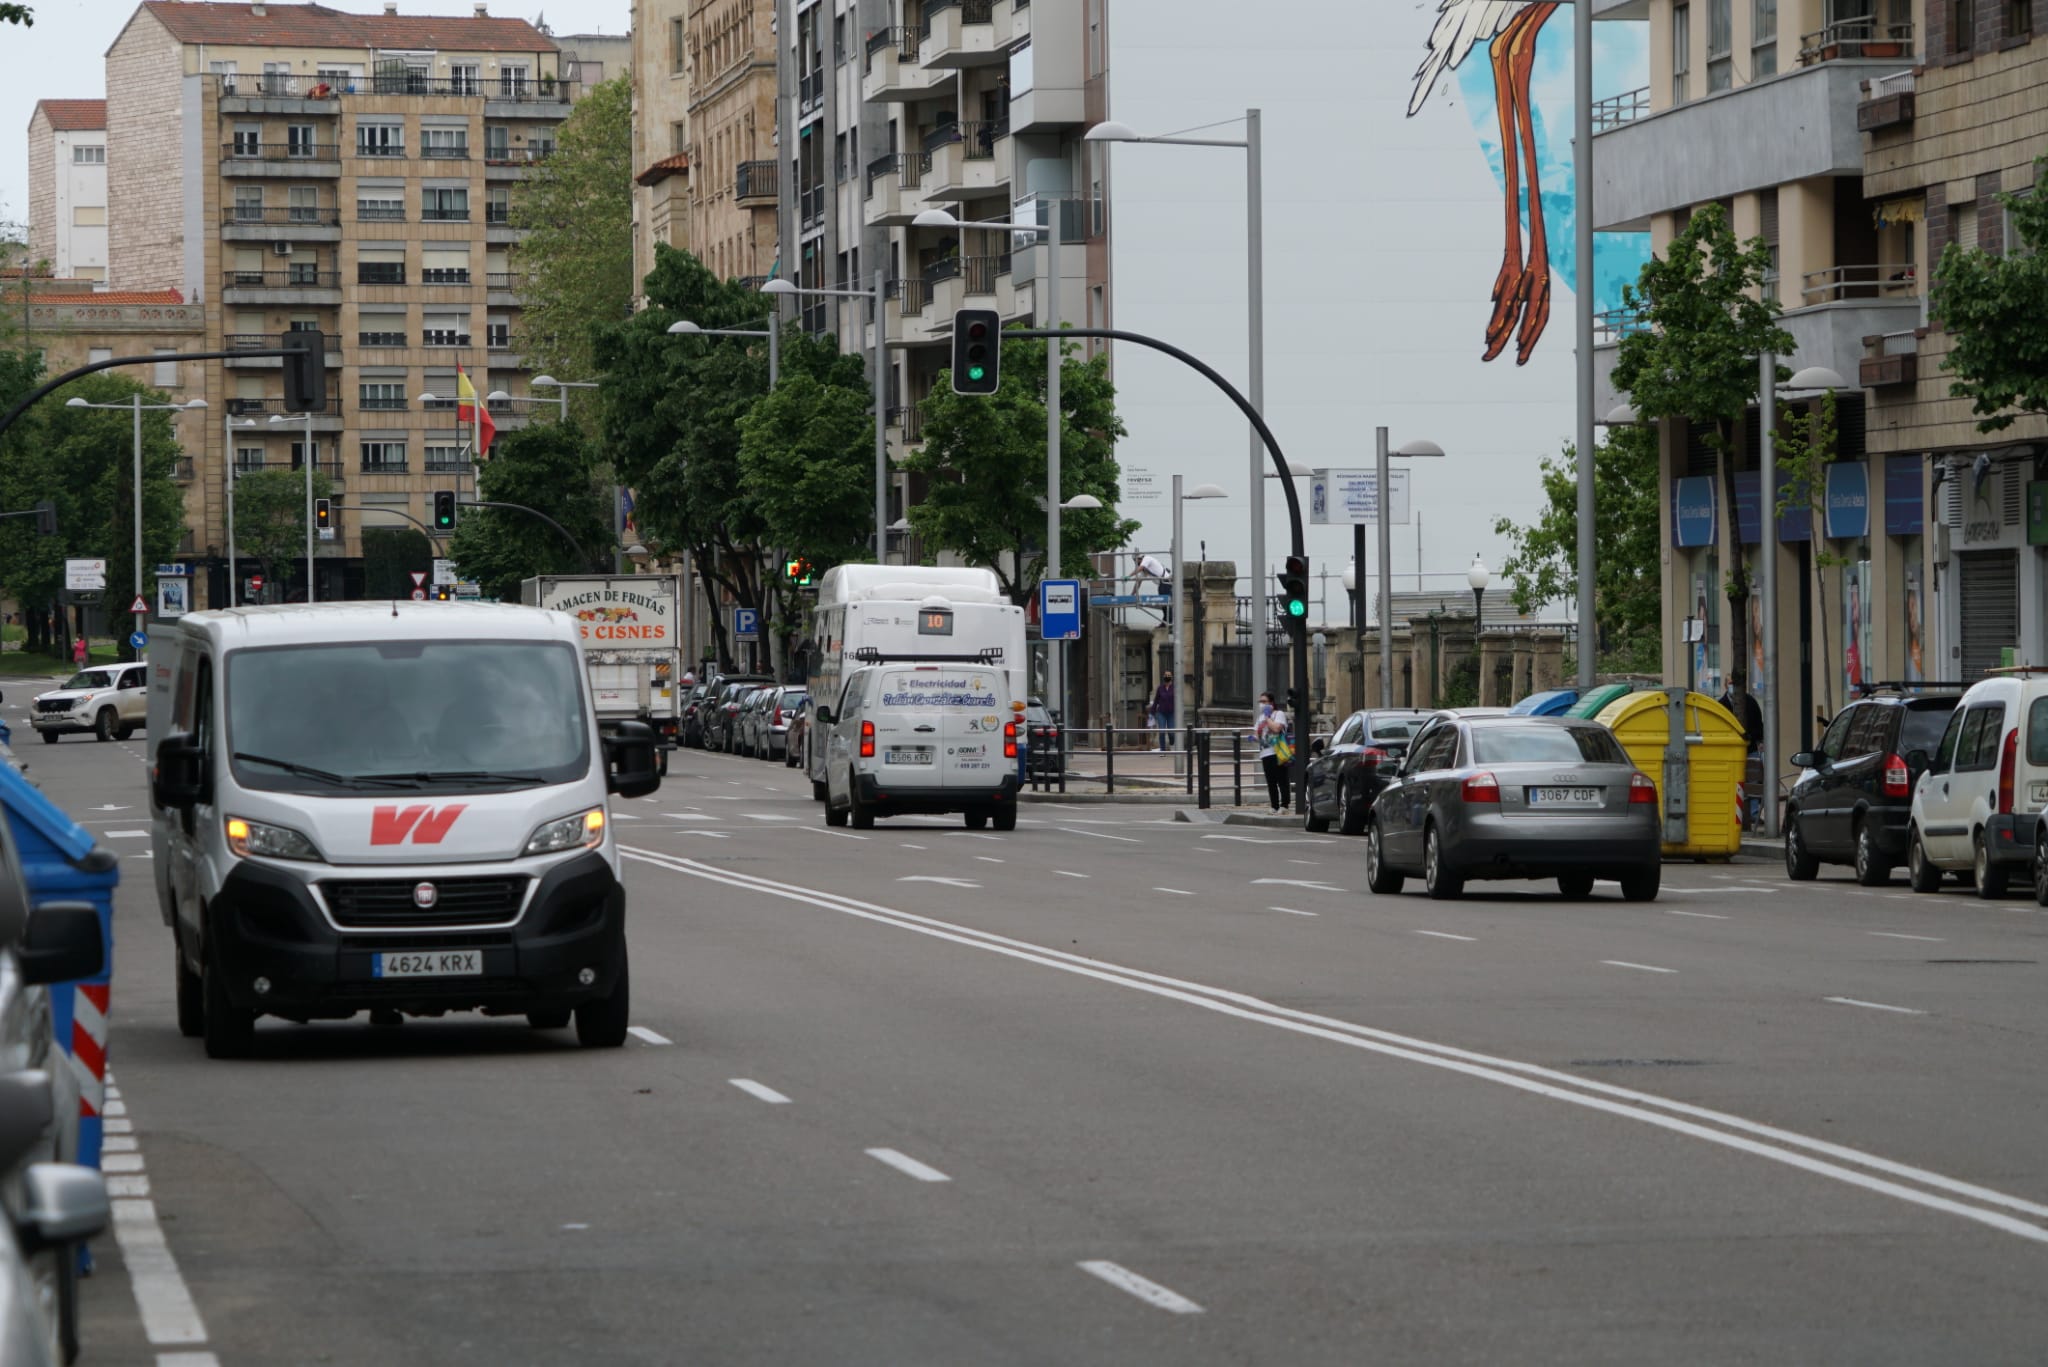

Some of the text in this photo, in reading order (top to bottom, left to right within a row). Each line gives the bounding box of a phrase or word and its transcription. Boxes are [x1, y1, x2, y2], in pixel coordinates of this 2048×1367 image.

[551, 590, 666, 616] LMACEN DE FRUTAS
[740, 611, 755, 631] P
[927, 614, 944, 628] 10
[580, 625, 666, 640] S CISNES
[909, 679, 967, 689] Electricidad
[1540, 789, 1596, 801] 3067 CDF
[388, 953, 475, 974] 4624 KRX
